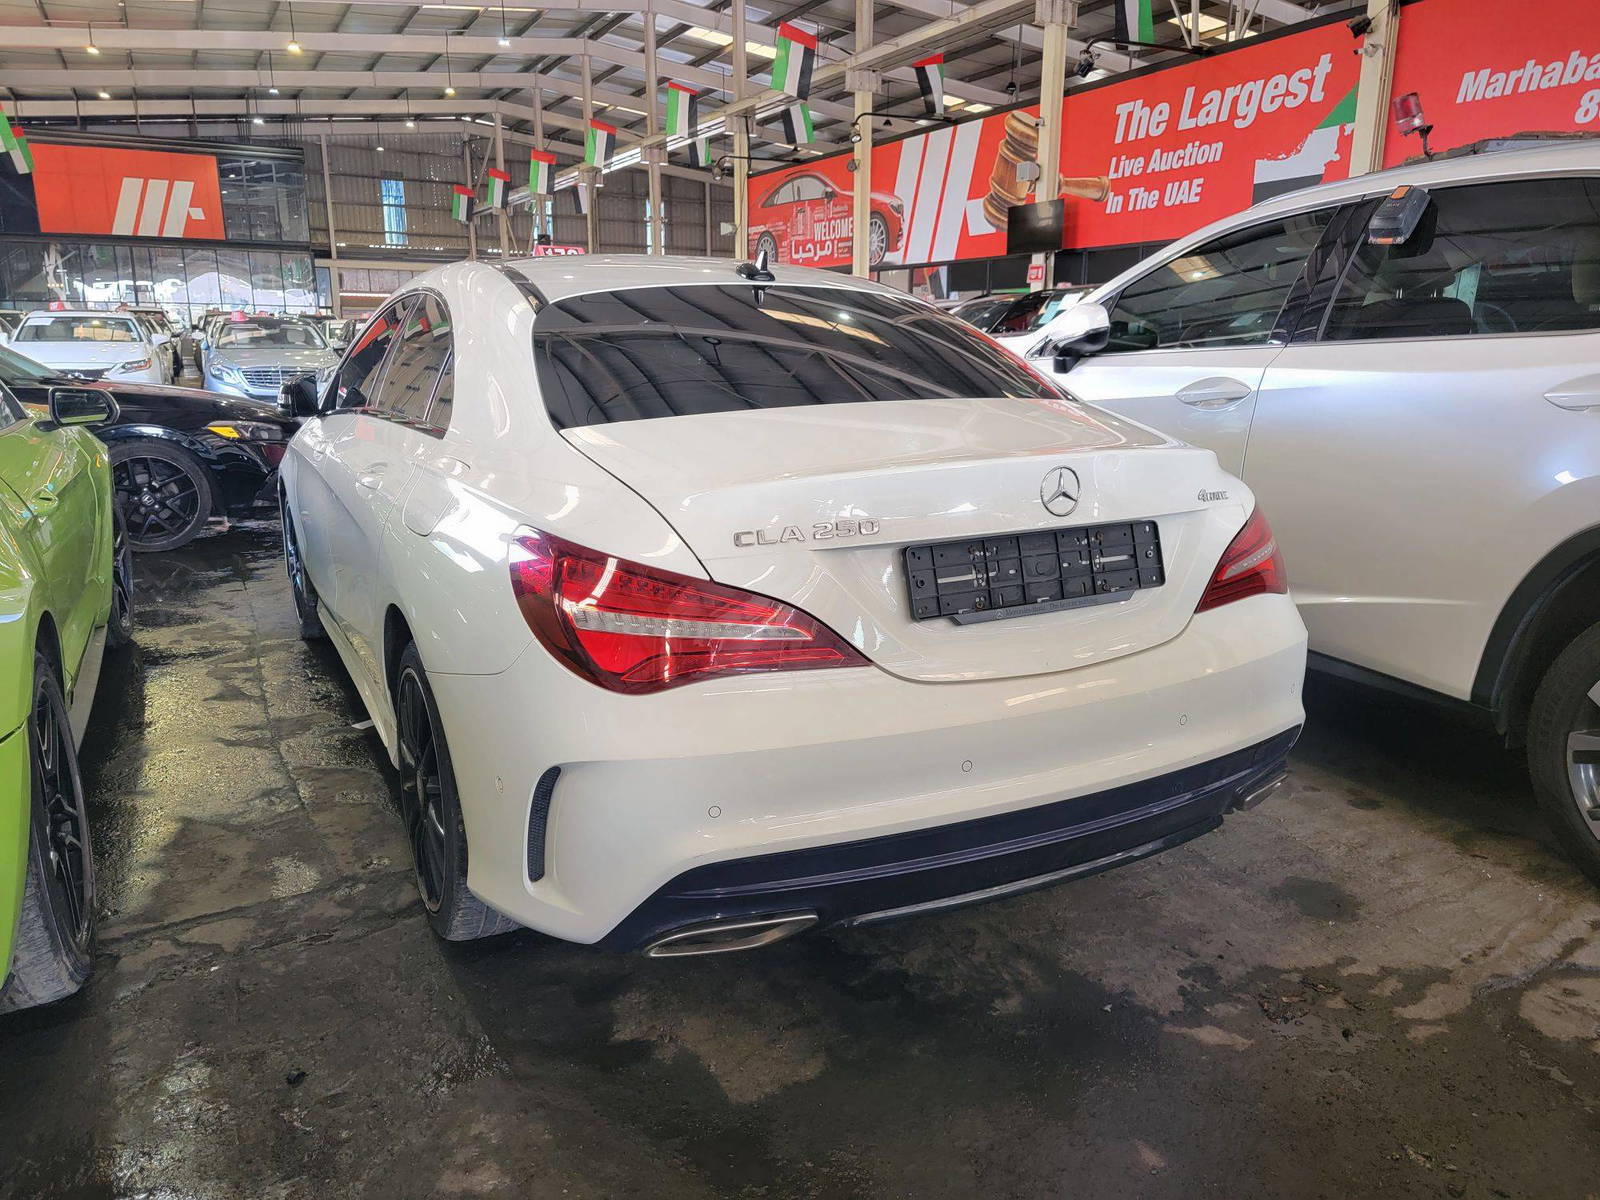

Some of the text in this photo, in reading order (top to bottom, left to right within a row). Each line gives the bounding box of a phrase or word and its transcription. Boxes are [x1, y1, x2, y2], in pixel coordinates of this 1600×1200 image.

[1455, 50, 1600, 104] Marhaba
[1114, 53, 1333, 144] The Largest
[1108, 141, 1224, 180] Live Auction
[1105, 178, 1204, 214] In The UAE
[813, 217, 853, 242] WELCOME
[733, 518, 880, 548] CLA 250
